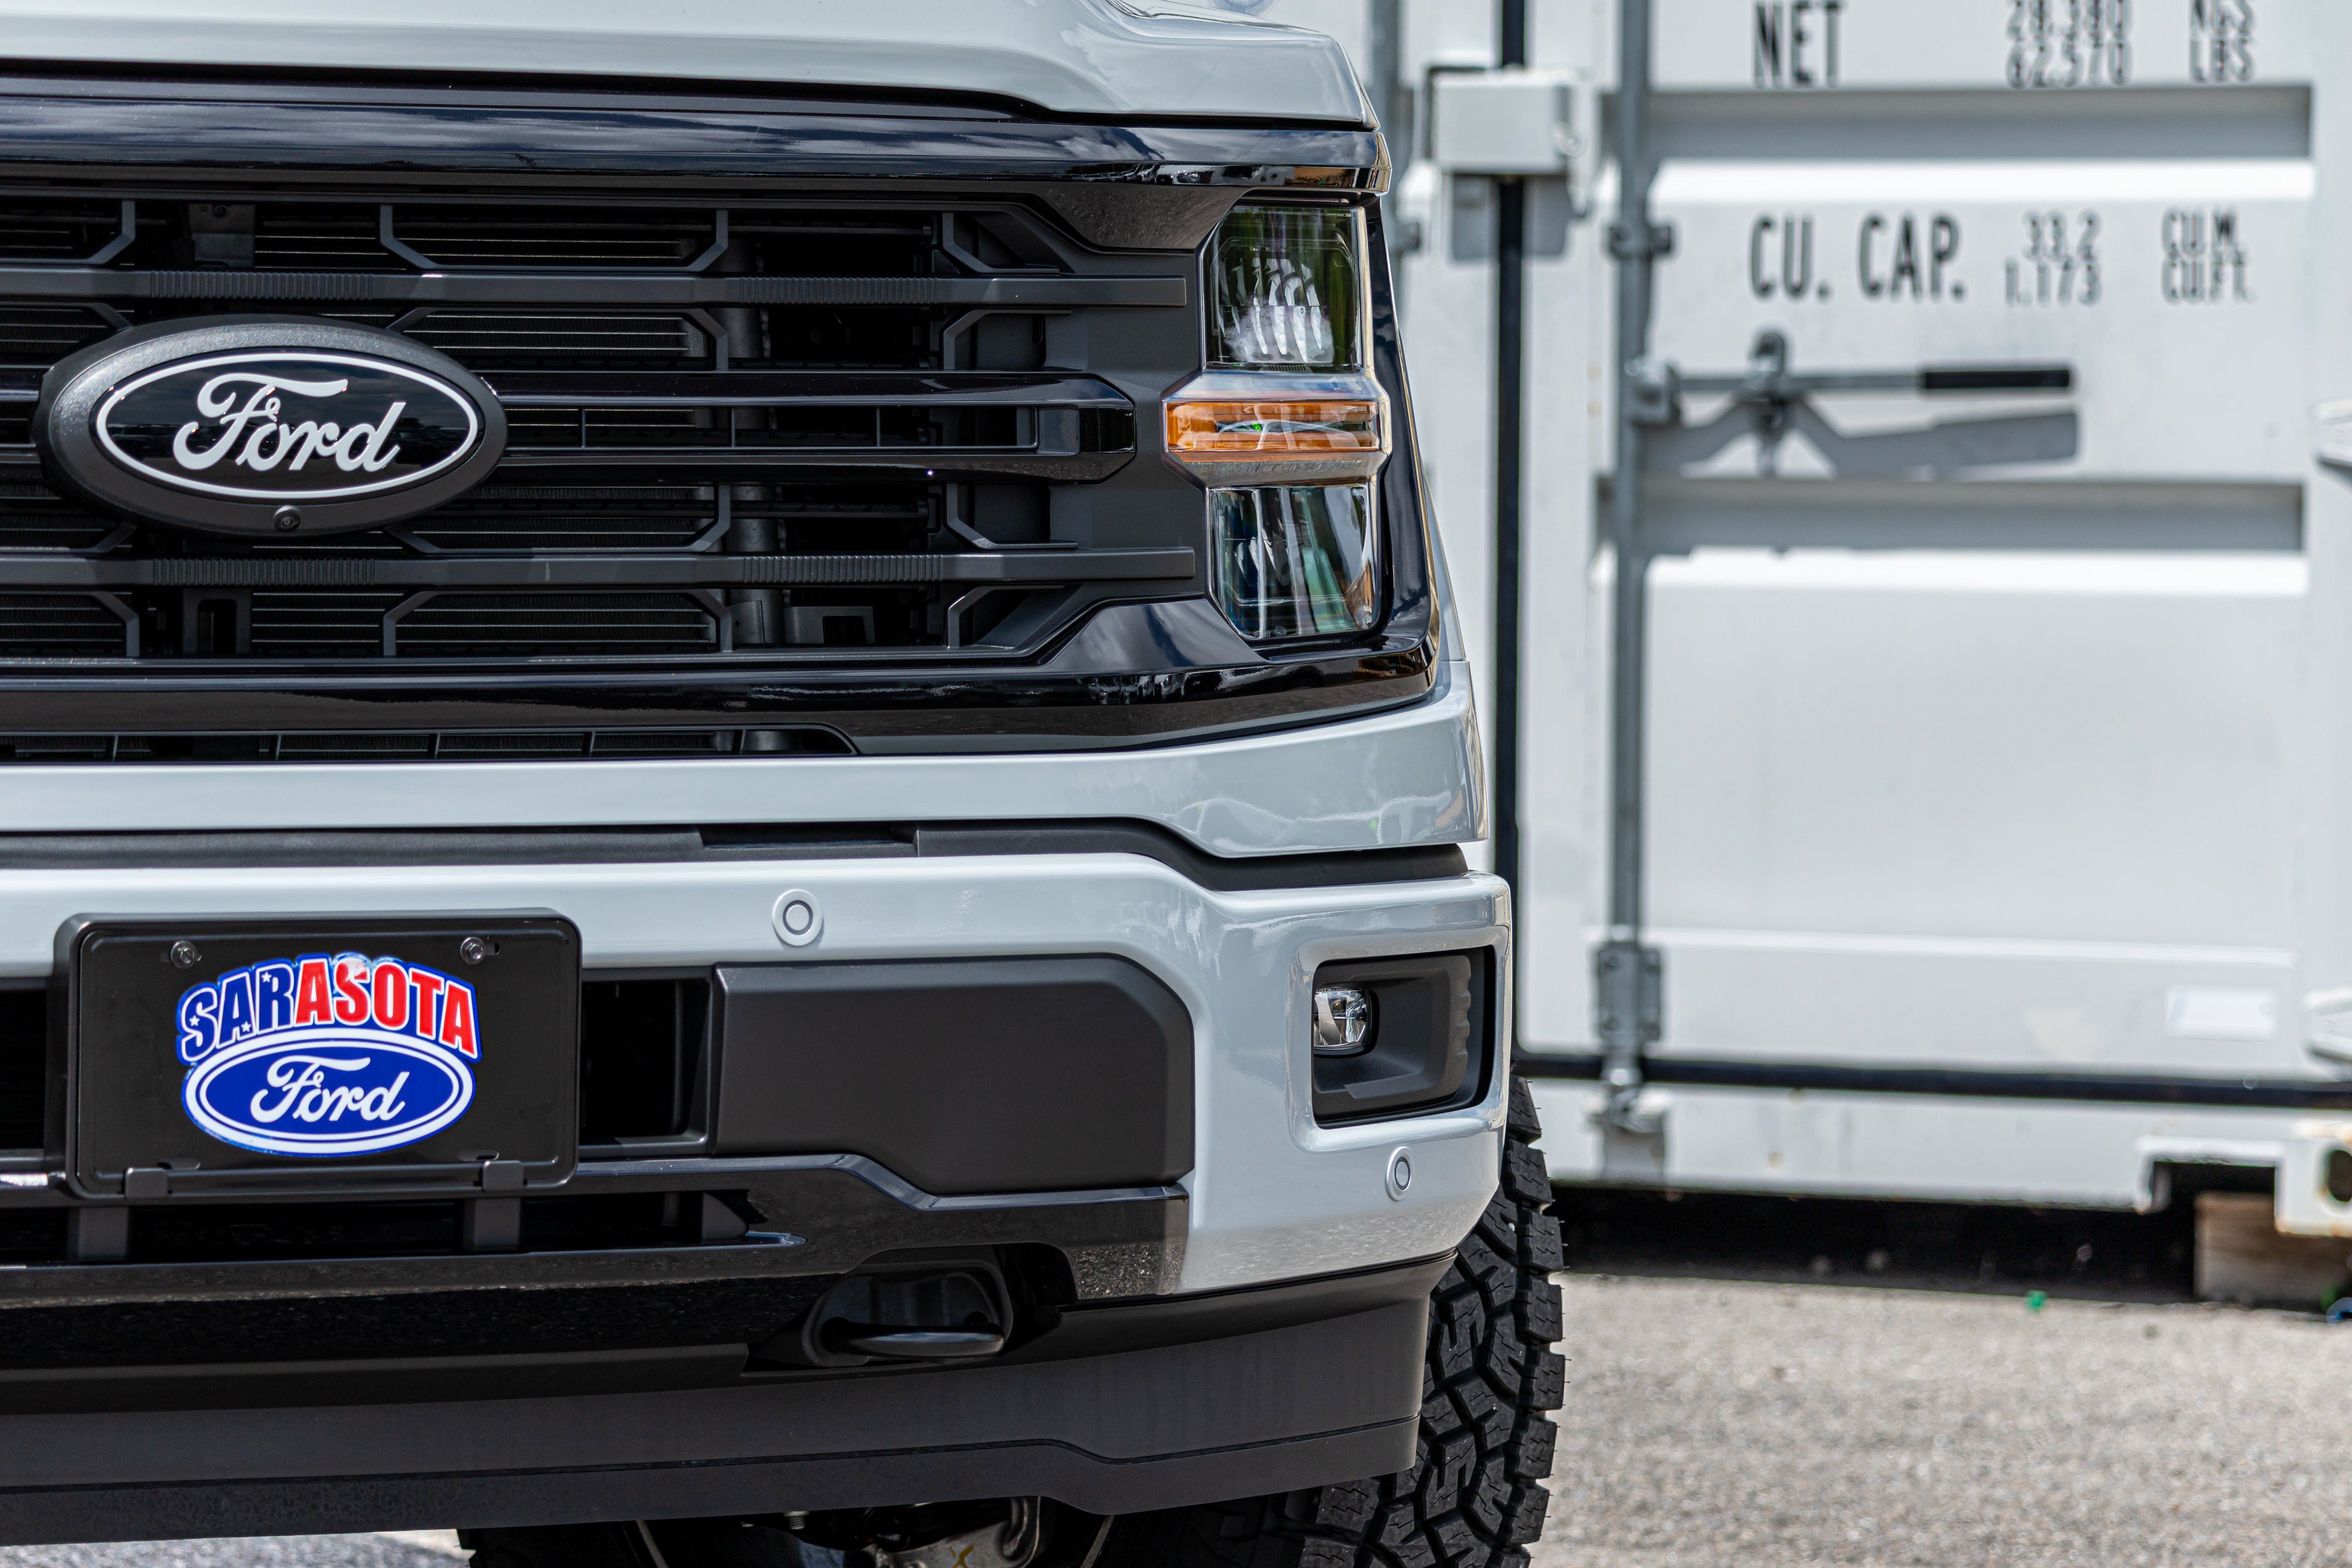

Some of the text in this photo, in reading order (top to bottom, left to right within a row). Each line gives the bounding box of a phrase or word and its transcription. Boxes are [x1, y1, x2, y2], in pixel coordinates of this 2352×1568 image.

[1752, 0, 1846, 86] NET
[2189, 39, 2255, 83] LBS
[1748, 211, 1968, 301] CU. CAP.
[172, 372, 407, 472] Ford
[180, 956, 479, 1063] SARASOTA
[250, 1055, 410, 1123] Ford
